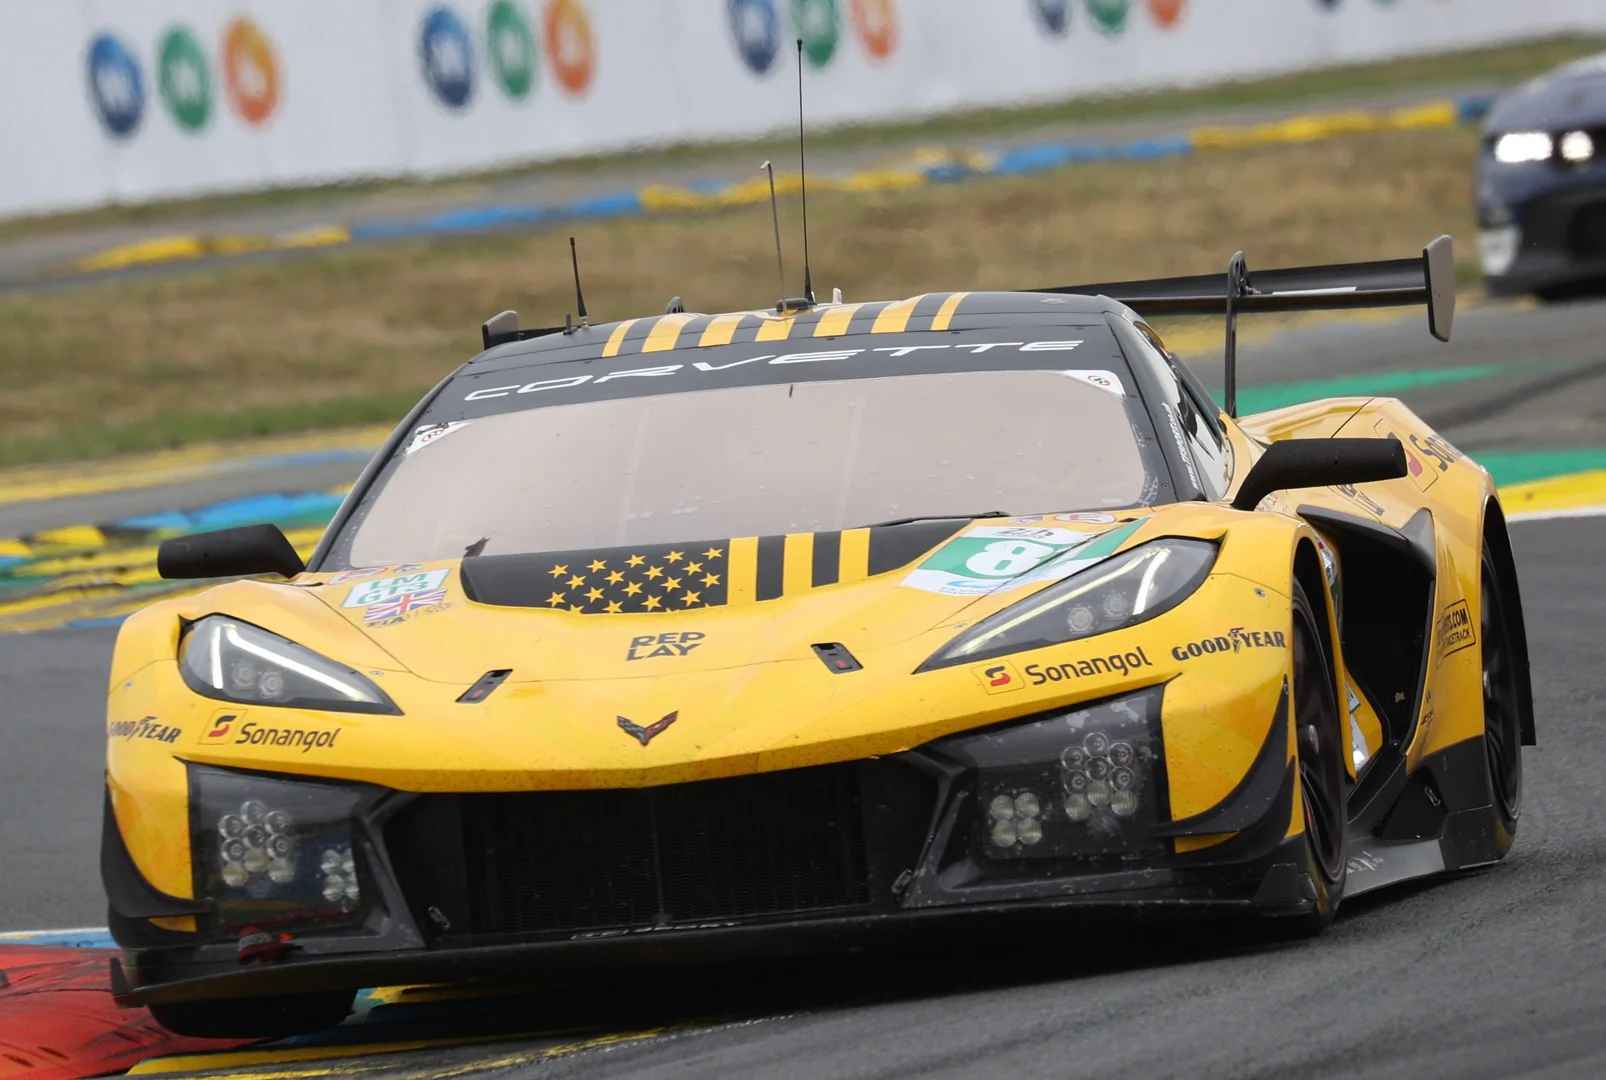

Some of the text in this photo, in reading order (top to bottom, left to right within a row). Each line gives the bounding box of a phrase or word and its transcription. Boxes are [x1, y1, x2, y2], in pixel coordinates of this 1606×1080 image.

[464, 338, 1084, 401] CORVETTE
[357, 581, 429, 605] GT3
[371, 573, 428, 591] LM
[625, 643, 703, 661] LAY
[630, 631, 706, 649] REP
[1171, 627, 1286, 662] GOODYEAR
[1025, 646, 1153, 686] Sonangol
[235, 723, 342, 753] Sonangol
